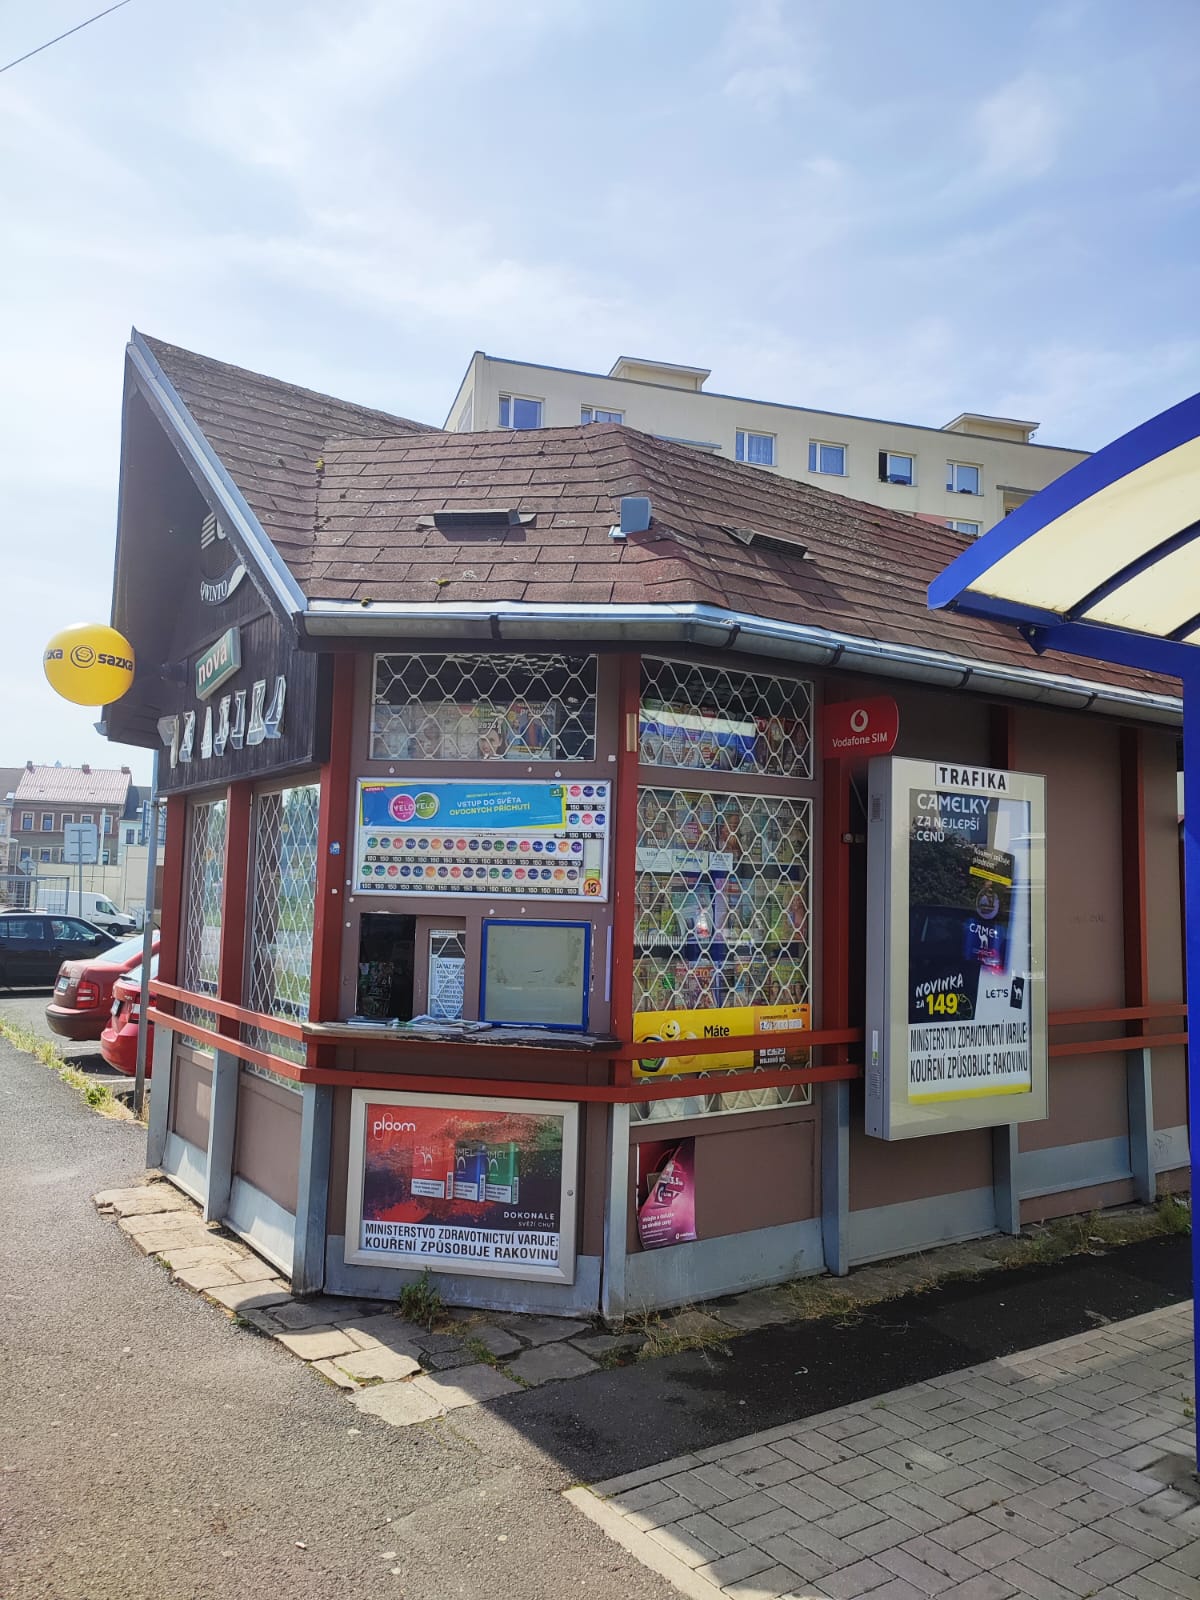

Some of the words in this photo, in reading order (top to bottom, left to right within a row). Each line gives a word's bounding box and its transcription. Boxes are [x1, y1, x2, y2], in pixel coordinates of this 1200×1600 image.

[97, 653, 134, 672] sazka
[198, 638, 228, 686] nova
[832, 735, 871, 748] Vodafone
[871, 731, 888, 743] SIM
[939, 766, 1007, 791] TRAFIKA
[393, 804, 414, 812] VELO
[456, 800, 482, 808] VSTUP
[483, 798, 495, 806] DO
[496, 796, 522, 805] SVĚTA
[916, 793, 990, 815] CAMELKY
[916, 815, 931, 827] ZA
[933, 816, 980, 831] NEJLEPŠÍ
[916, 830, 945, 843] CENU
[915, 973, 964, 998] NOVINKA
[985, 988, 1009, 999] LET'S
[915, 1001, 925, 1009] ZA
[926, 992, 958, 1016] 149
[703, 1023, 730, 1038] Máte
[910, 1025, 957, 1053] MINISTERSTVO
[957, 1019, 1005, 1049] ZDRAVOTNICTVÍ
[1005, 1021, 1028, 1045] VARUJE:
[910, 1053, 945, 1083] KOUŘENÍ
[947, 1050, 991, 1079] ZPŮSOBUJE
[992, 1050, 1028, 1075] RAKOVINU
[373, 1112, 416, 1140] ploom
[503, 1210, 555, 1221] DOKONALE
[365, 1222, 435, 1240] MINISTERSTVO
[438, 1228, 515, 1245] ZDRAVOTNICTVÍ
[517, 1232, 559, 1248] VARUJE:
[365, 1236, 417, 1251] KOUŘENÍ
[420, 1240, 490, 1258] ZPŮSOBUJE
[494, 1246, 559, 1262] RAKOVINU
